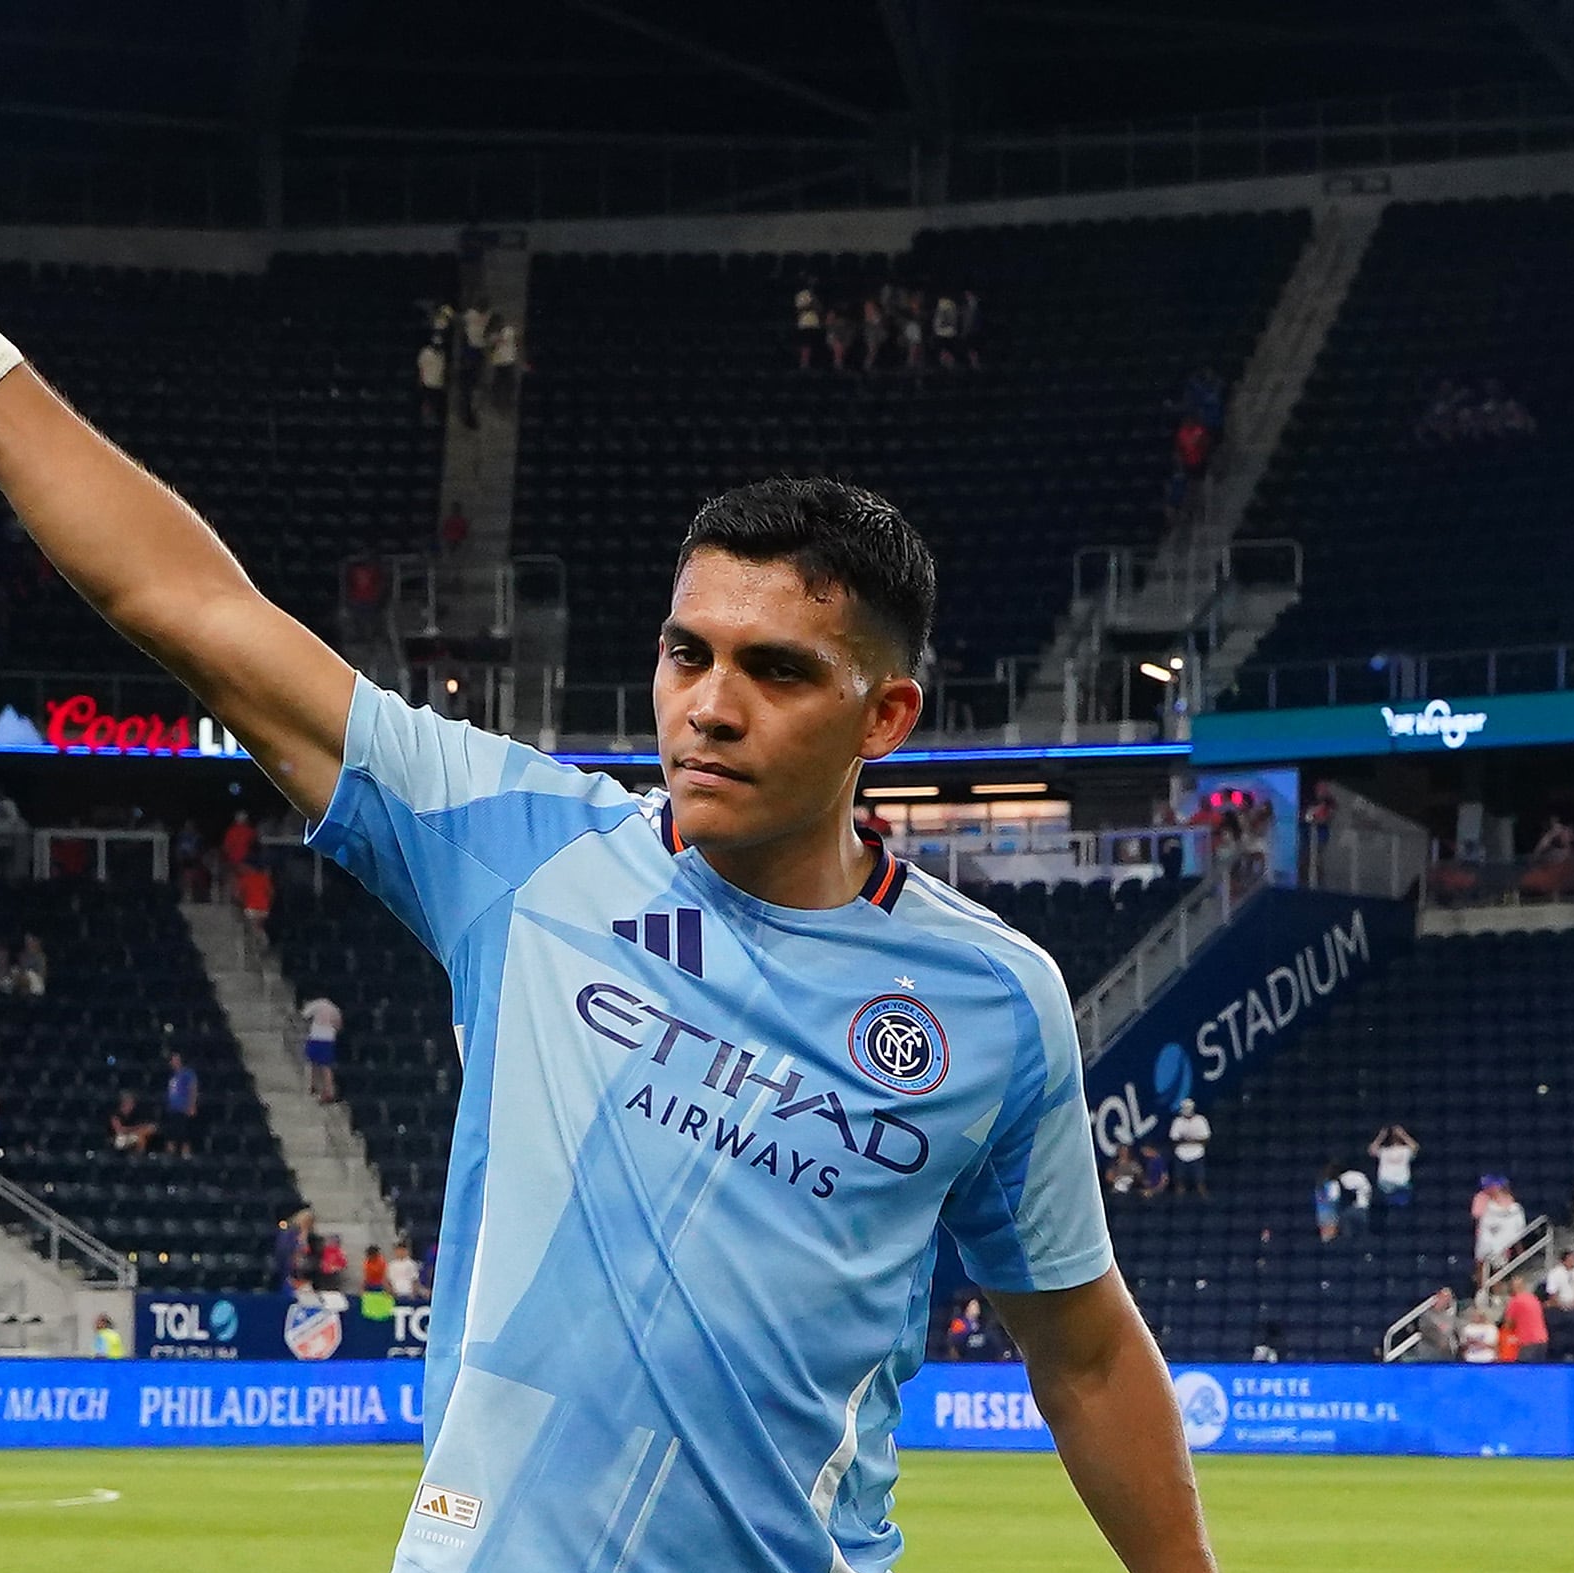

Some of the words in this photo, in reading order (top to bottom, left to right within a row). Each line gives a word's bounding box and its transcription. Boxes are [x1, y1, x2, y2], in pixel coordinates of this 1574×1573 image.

[46, 695, 191, 752] Coors
[1091, 1082, 1158, 1157] QL
[1196, 909, 1370, 1081] STADIUM
[576, 982, 929, 1175] ETIHAD
[625, 1083, 841, 1199] AIRWAYS
[150, 1302, 209, 1341] TQL
[391, 1306, 430, 1342] TQ
[4, 1387, 109, 1422] MATCH
[140, 1384, 387, 1428] PHILADELPHIA
